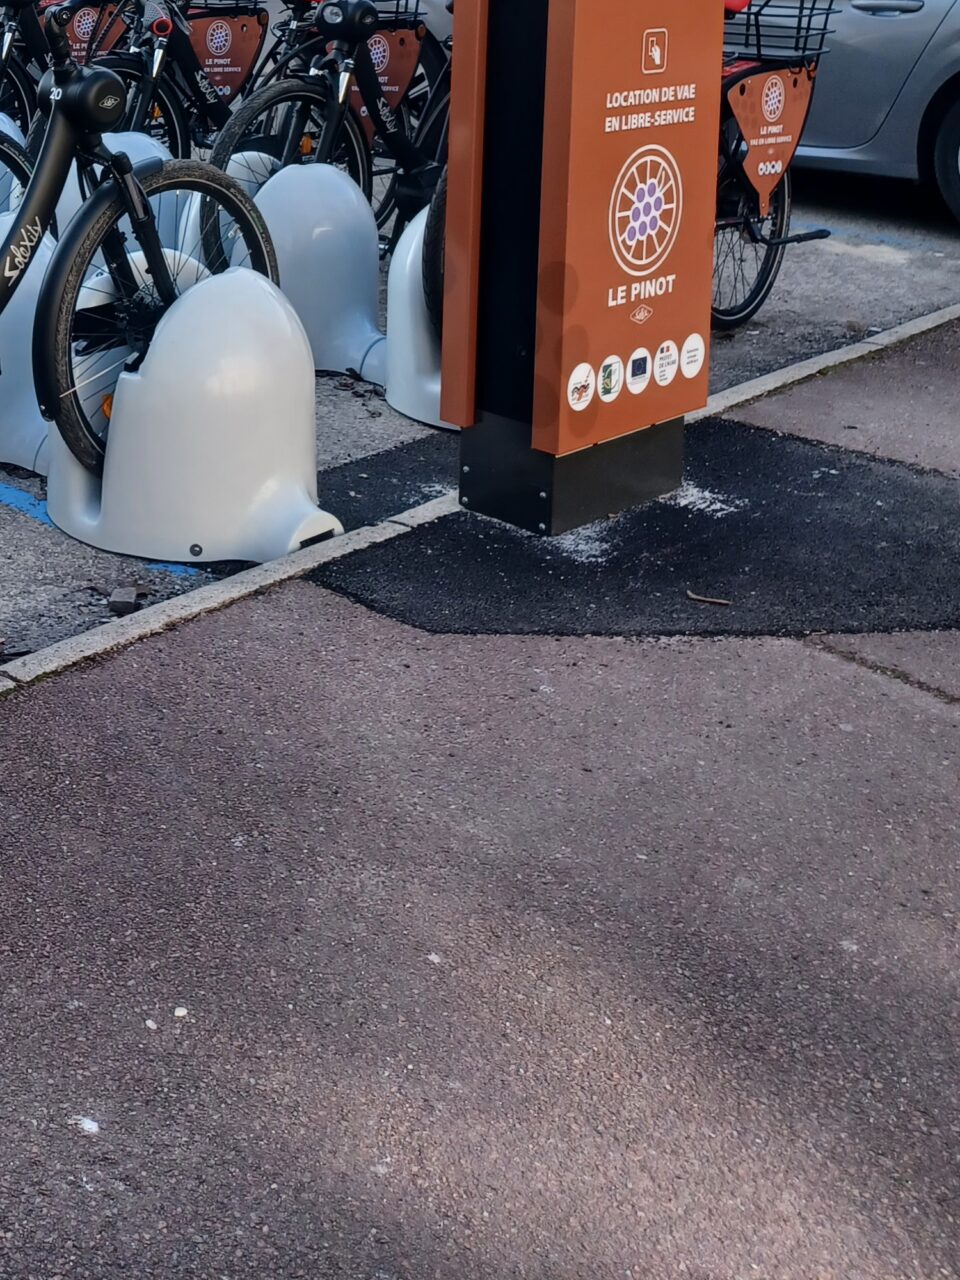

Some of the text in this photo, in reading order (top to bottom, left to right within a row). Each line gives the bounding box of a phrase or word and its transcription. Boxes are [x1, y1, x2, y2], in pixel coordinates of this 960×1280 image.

[49, 87, 62, 100] 20
[606, 84, 696, 108] LOCATION DE VAE
[604, 107, 696, 132] EN LIBRE-SERVICE
[607, 274, 677, 308] LE PINOT
